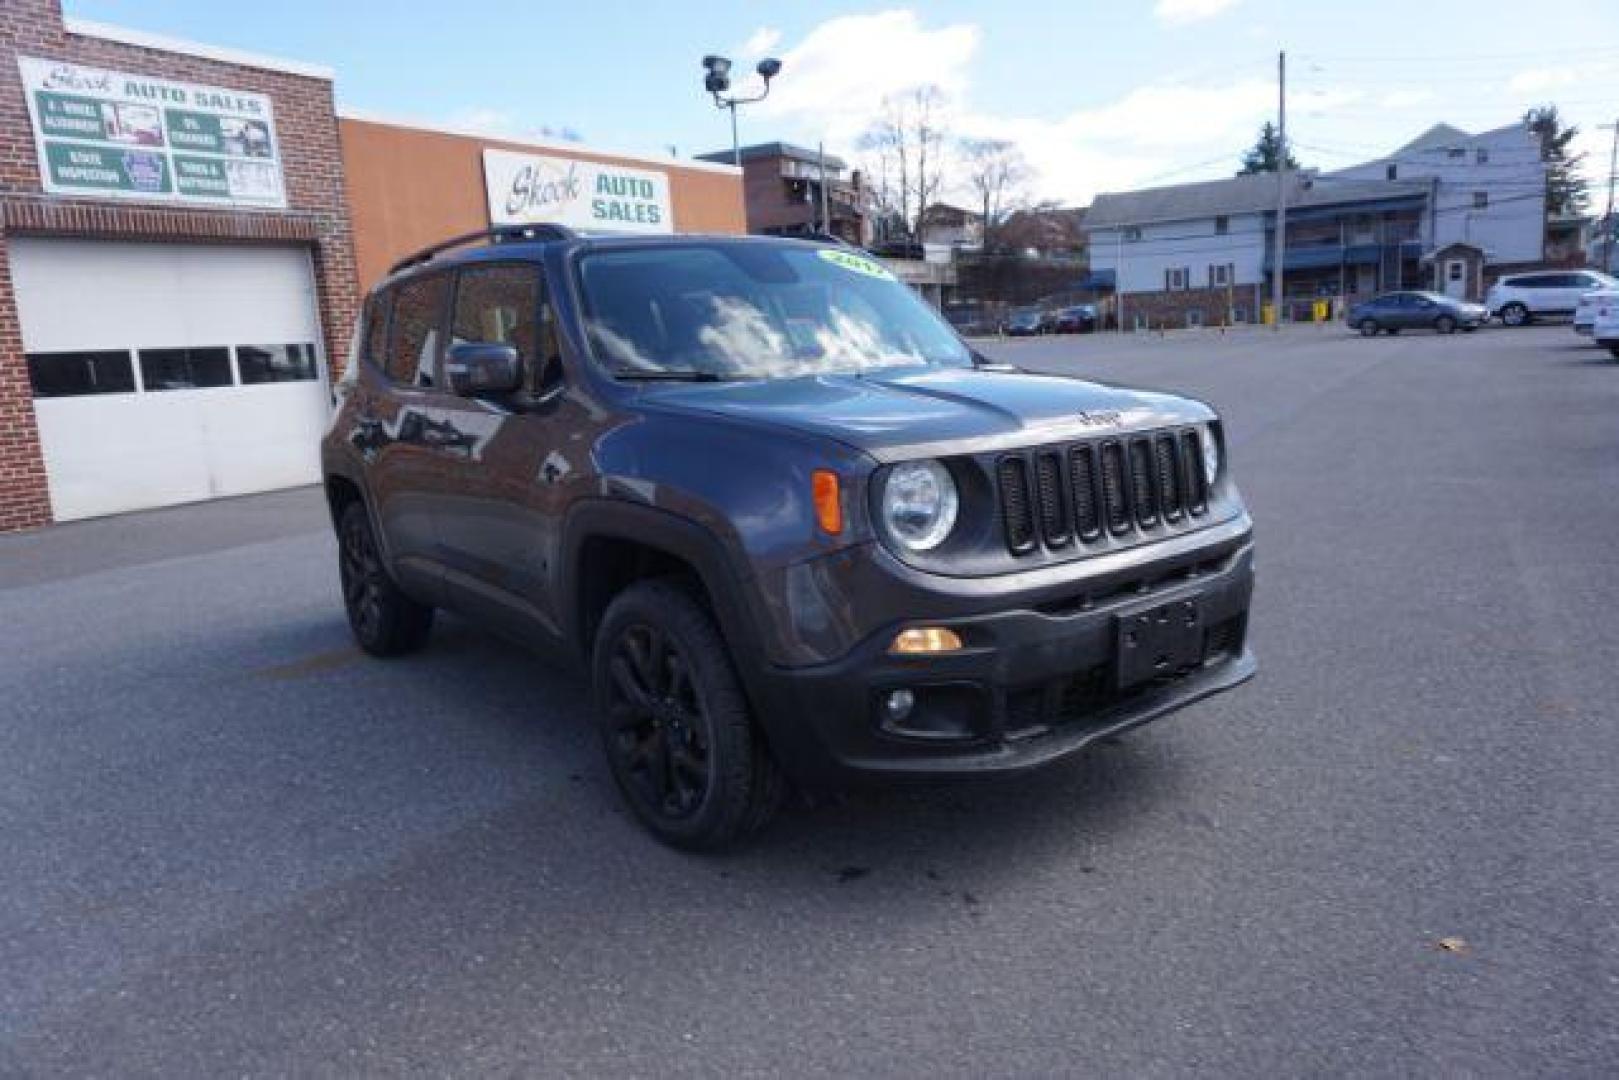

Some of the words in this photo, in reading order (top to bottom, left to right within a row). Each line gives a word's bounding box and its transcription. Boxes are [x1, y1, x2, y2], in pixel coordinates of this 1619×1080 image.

[125, 81, 186, 102] AUTO
[195, 92, 262, 113] SALES
[597, 174, 654, 200] AUTO
[592, 199, 661, 224] SALES
